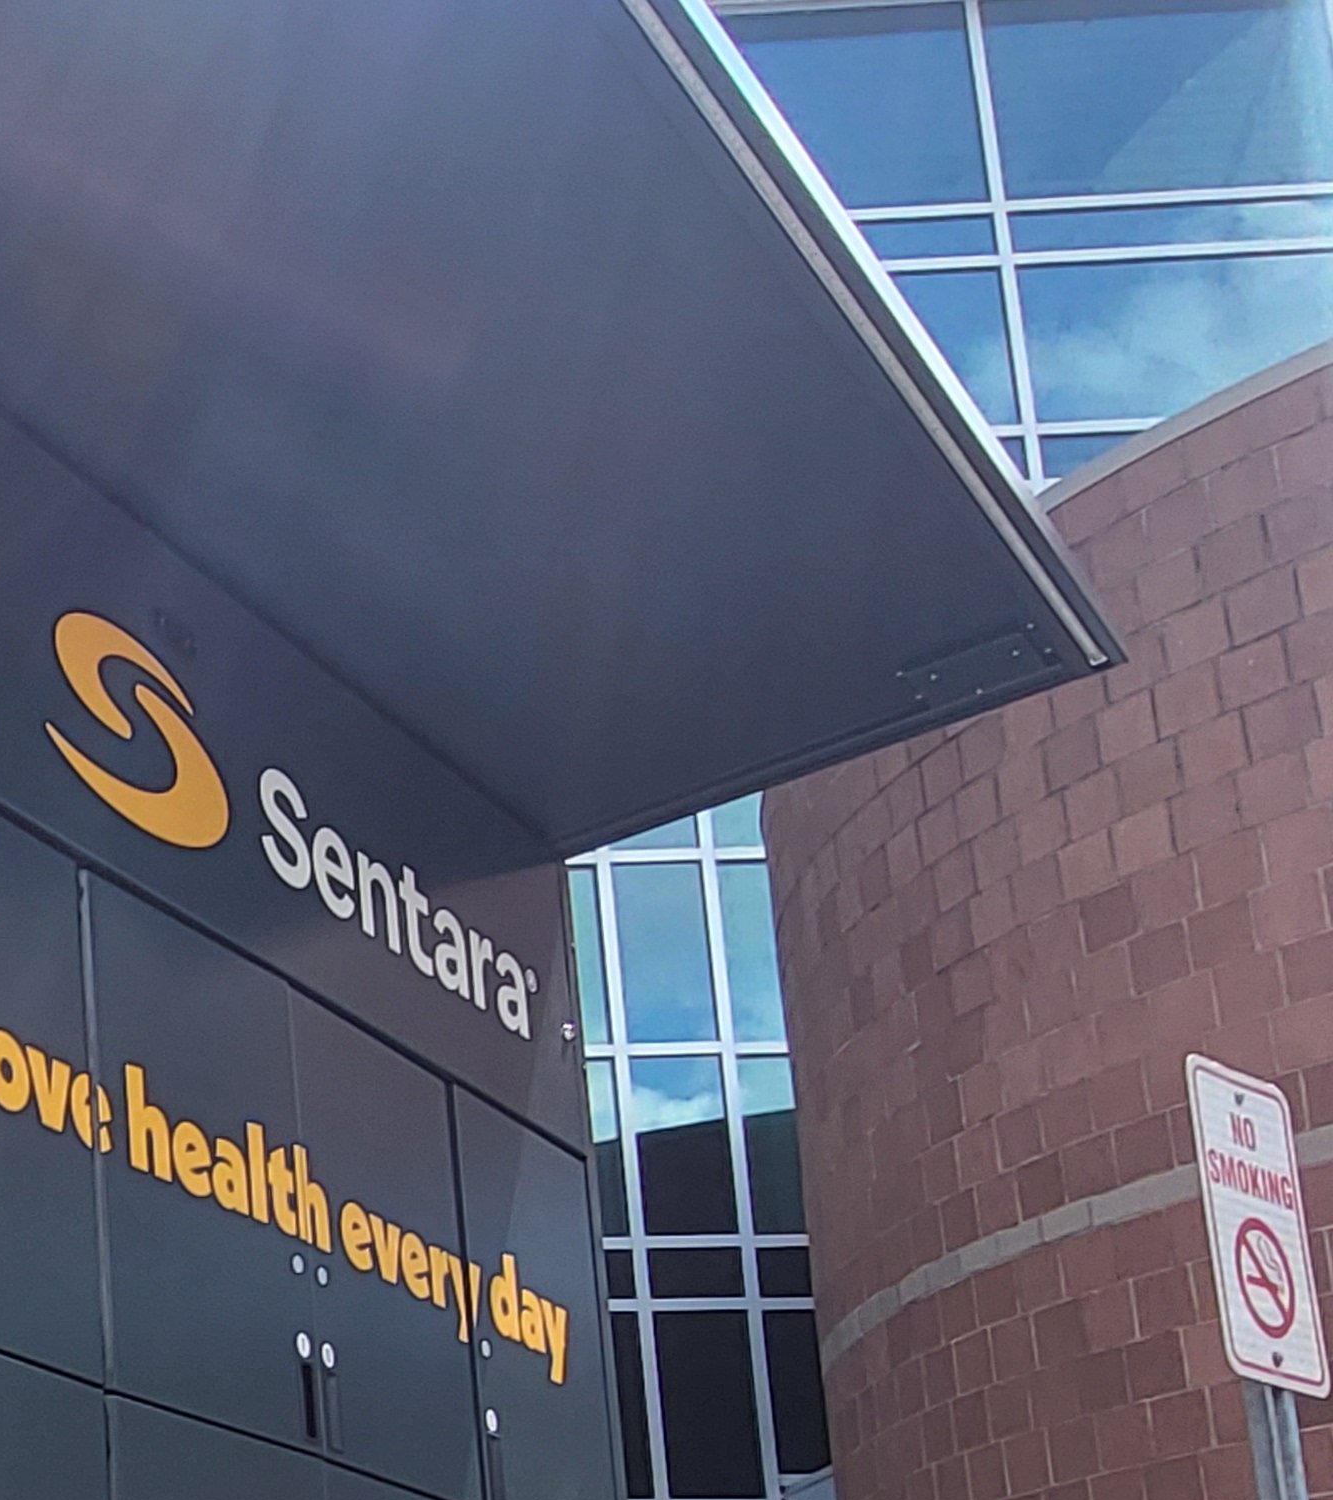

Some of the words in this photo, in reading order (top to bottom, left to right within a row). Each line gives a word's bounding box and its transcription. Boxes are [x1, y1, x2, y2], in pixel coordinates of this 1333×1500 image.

[259, 767, 532, 1041] Sentara
[1207, 1148, 1294, 1210] SMOKING
[1229, 1112, 1257, 1151] NO
[123, 1062, 332, 1252] health
[339, 1200, 480, 1343] every
[489, 1253, 568, 1384] day
